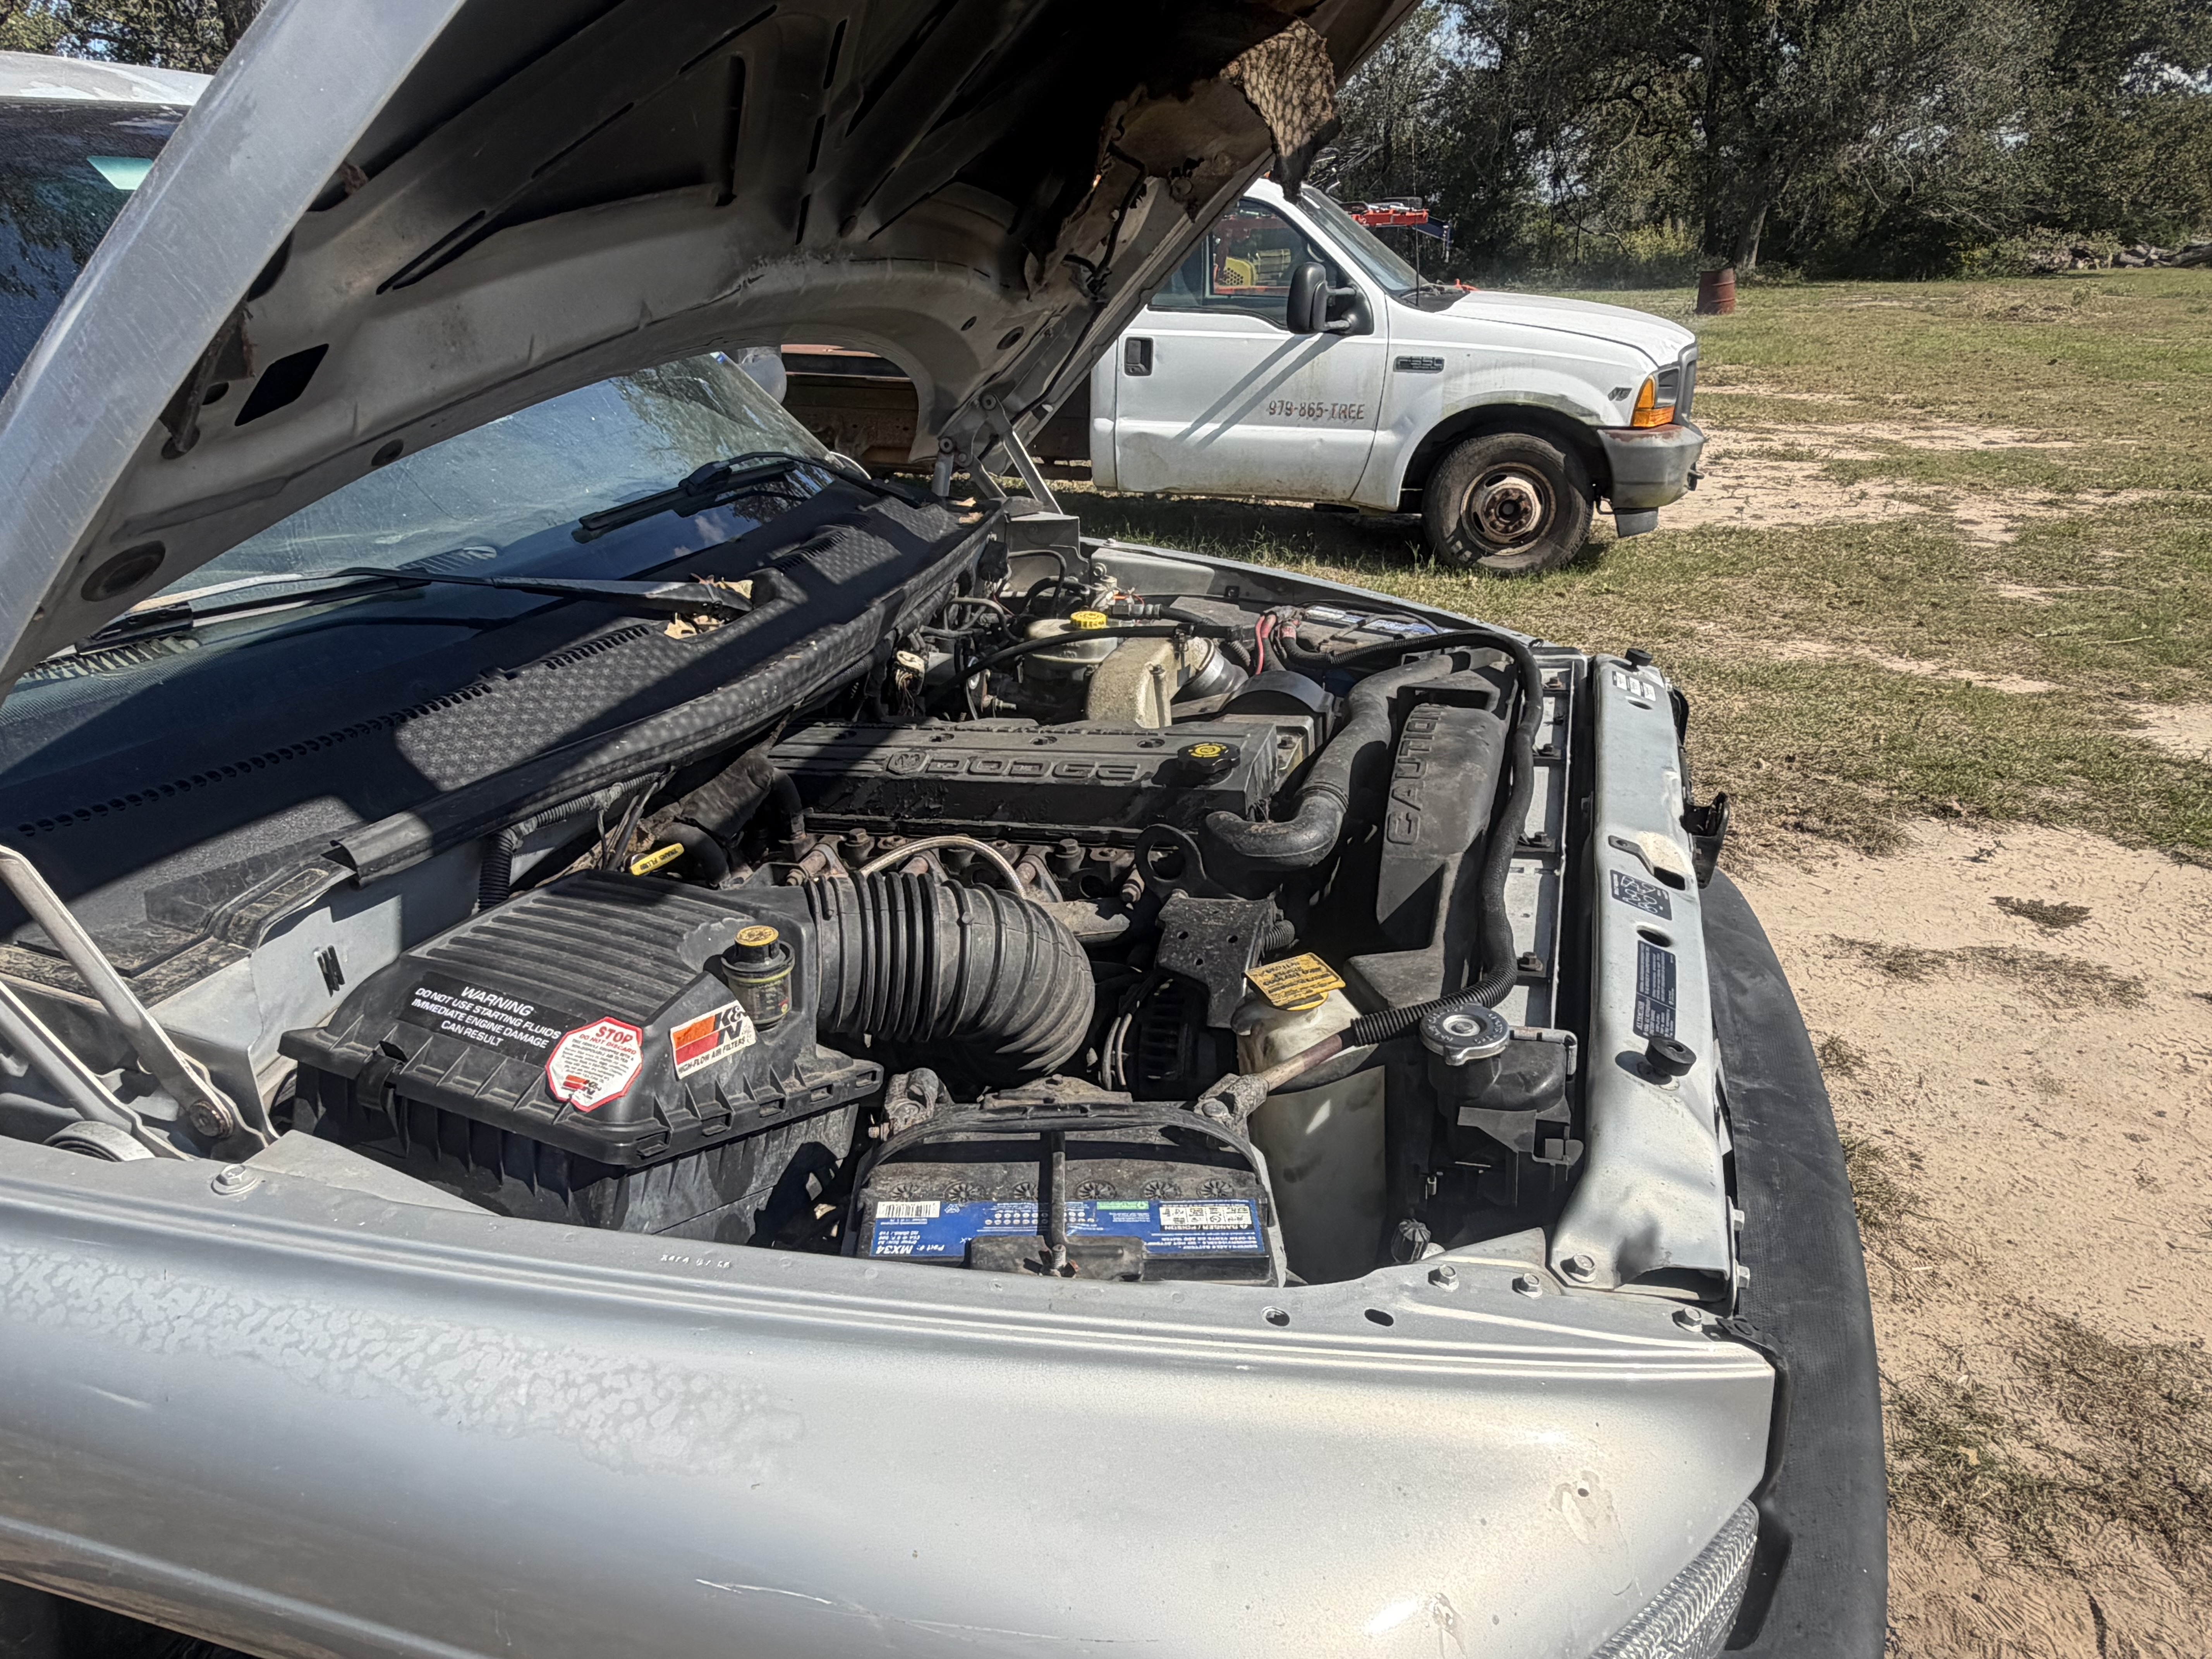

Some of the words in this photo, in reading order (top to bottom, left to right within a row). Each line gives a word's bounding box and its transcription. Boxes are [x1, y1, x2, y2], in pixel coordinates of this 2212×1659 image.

[1269, 400, 1365, 419] 979-865-TREE
[925, 755, 1140, 781] DODGE
[415, 988, 432, 998] DO
[430, 992, 453, 1004] NOT
[452, 998, 474, 1011] USE
[472, 1005, 523, 1027] STARTING
[522, 1020, 562, 1039] FLUIDS
[460, 986, 534, 1017] WARNING
[411, 998, 466, 1021] IMMEDIATE
[465, 1015, 505, 1034] ENGINE
[503, 1027, 549, 1049] DAMAGE
[441, 1020, 465, 1034] CAN
[463, 1027, 504, 1047] RESULT
[596, 1026, 633, 1044] STOP
[714, 1006, 747, 1046] K&N
[606, 1042, 637, 1055] DISCARD
[723, 1036, 745, 1053] FILTERS
[876, 1245, 914, 1254] MX34
